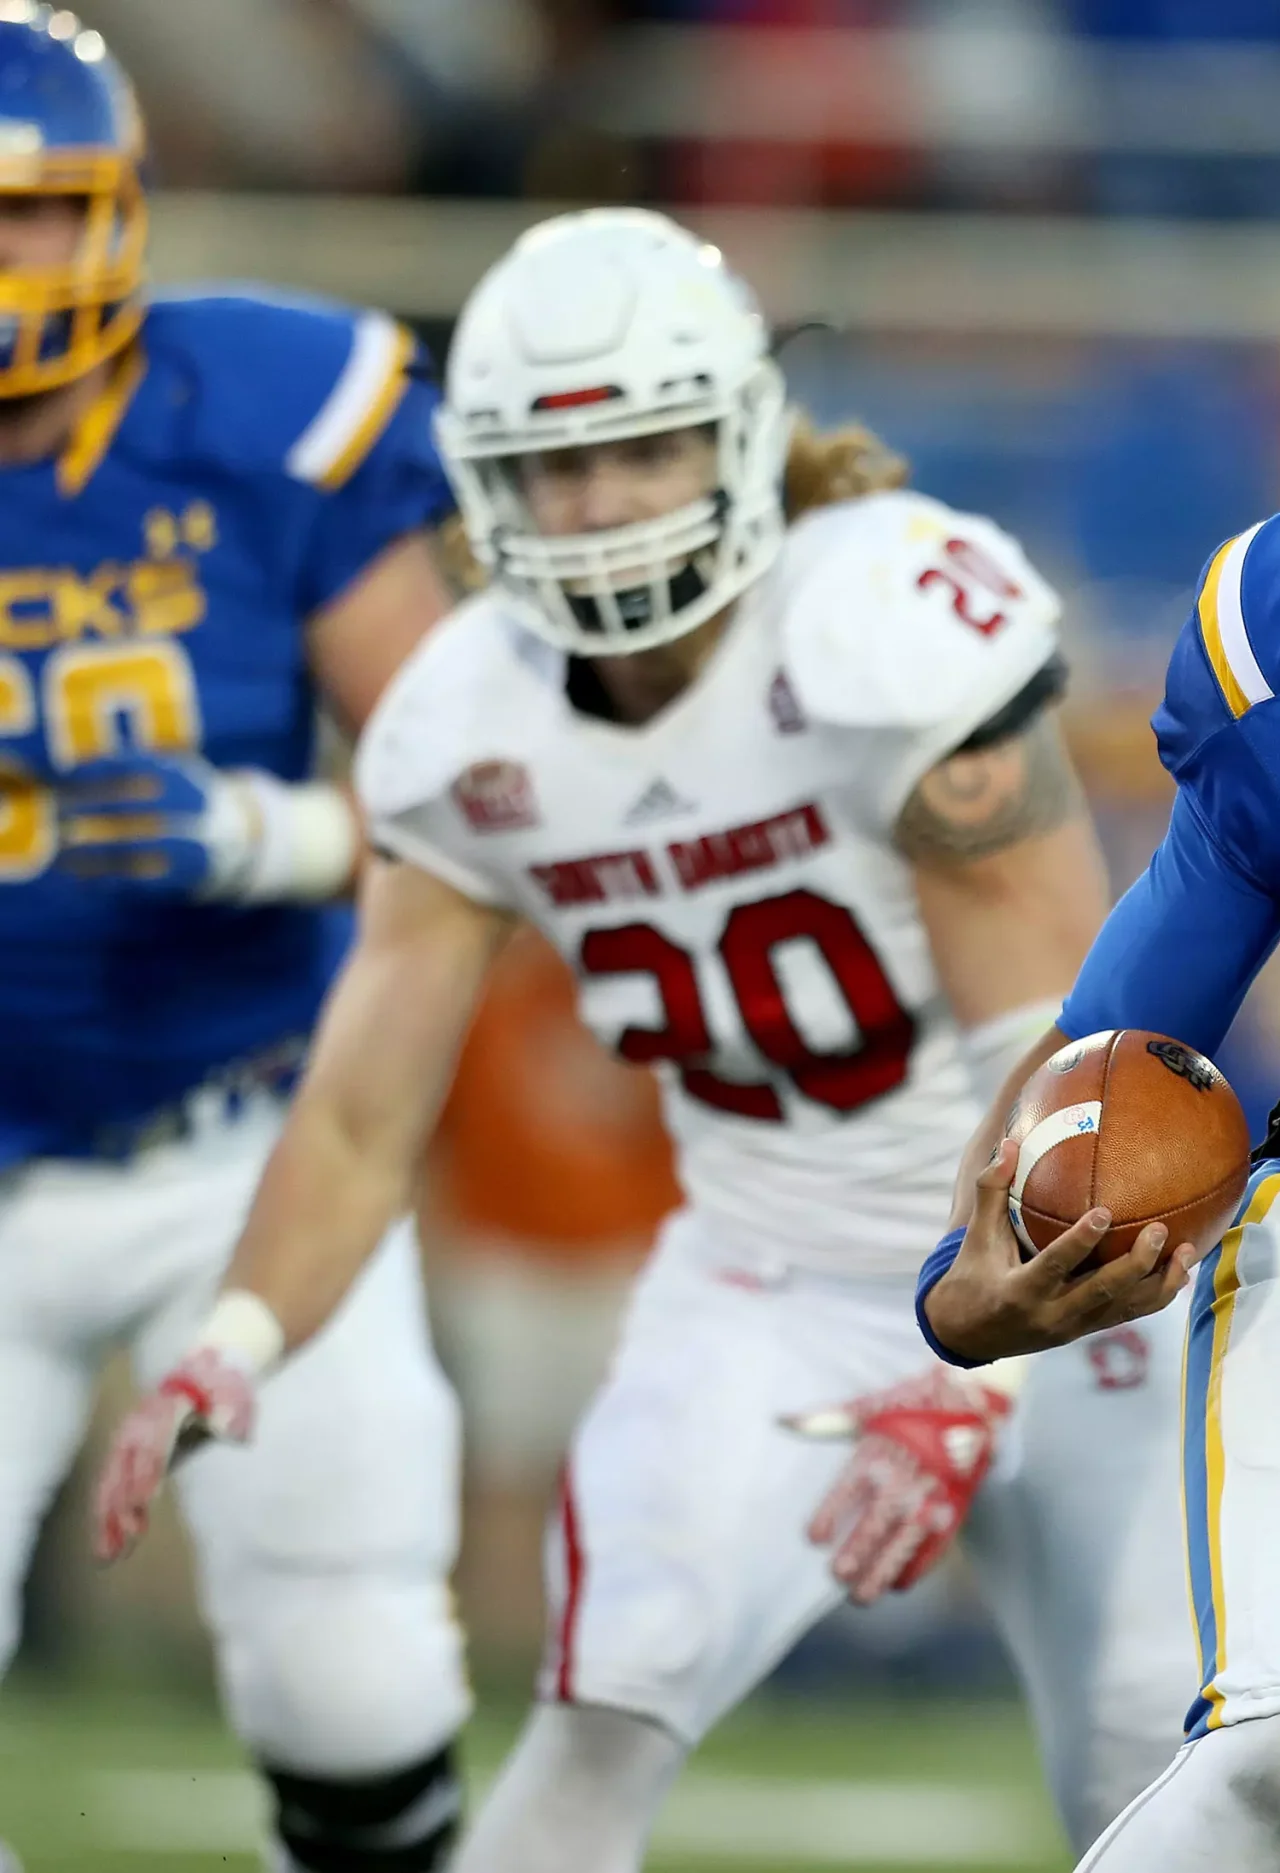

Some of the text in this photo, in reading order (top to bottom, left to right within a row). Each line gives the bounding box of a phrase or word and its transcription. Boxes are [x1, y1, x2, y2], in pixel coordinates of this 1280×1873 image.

[0, 560, 207, 646] CKS
[528, 802, 834, 908] SOUTH DAKOTA
[582, 888, 917, 1123] 20
